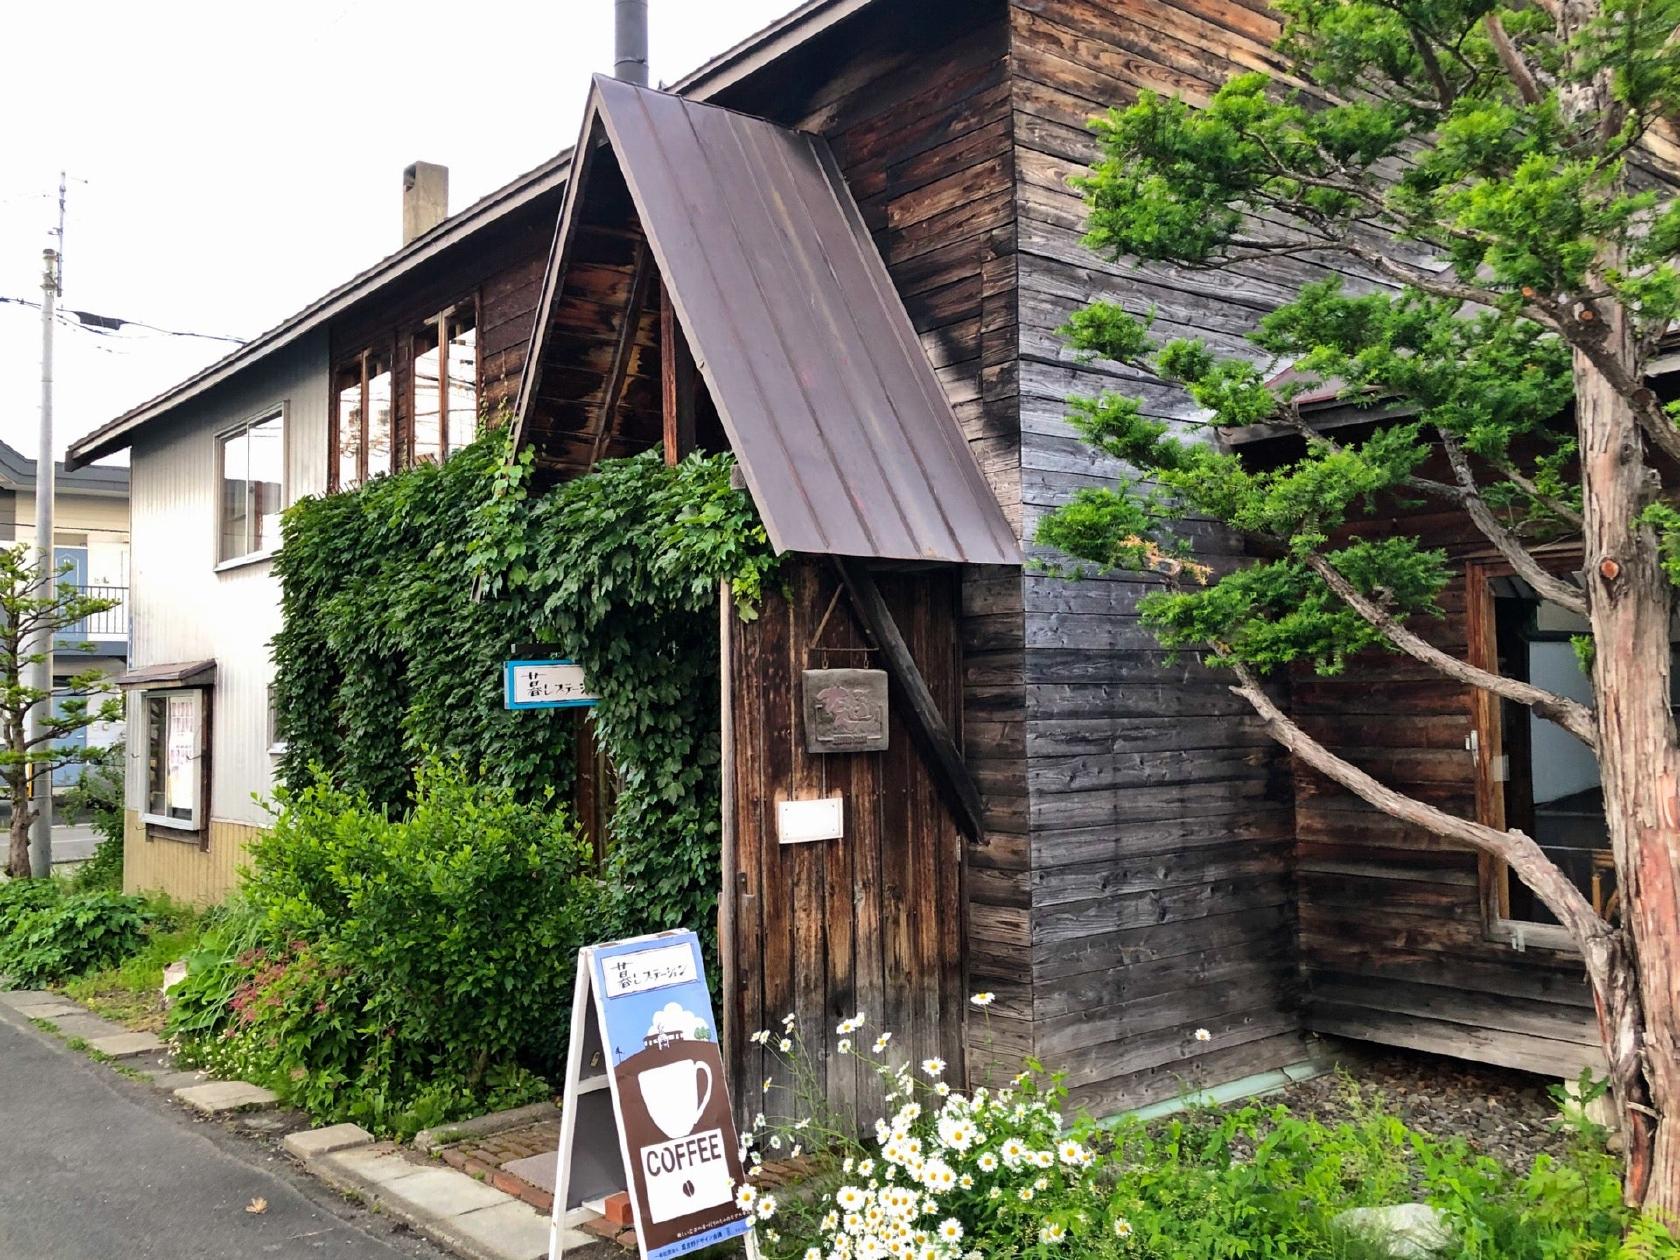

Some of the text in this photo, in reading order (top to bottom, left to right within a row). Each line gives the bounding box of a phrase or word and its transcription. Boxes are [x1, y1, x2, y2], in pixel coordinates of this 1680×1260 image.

[611, 962, 687, 989] 暮しステーション
[647, 1134, 721, 1176] COFFEE
